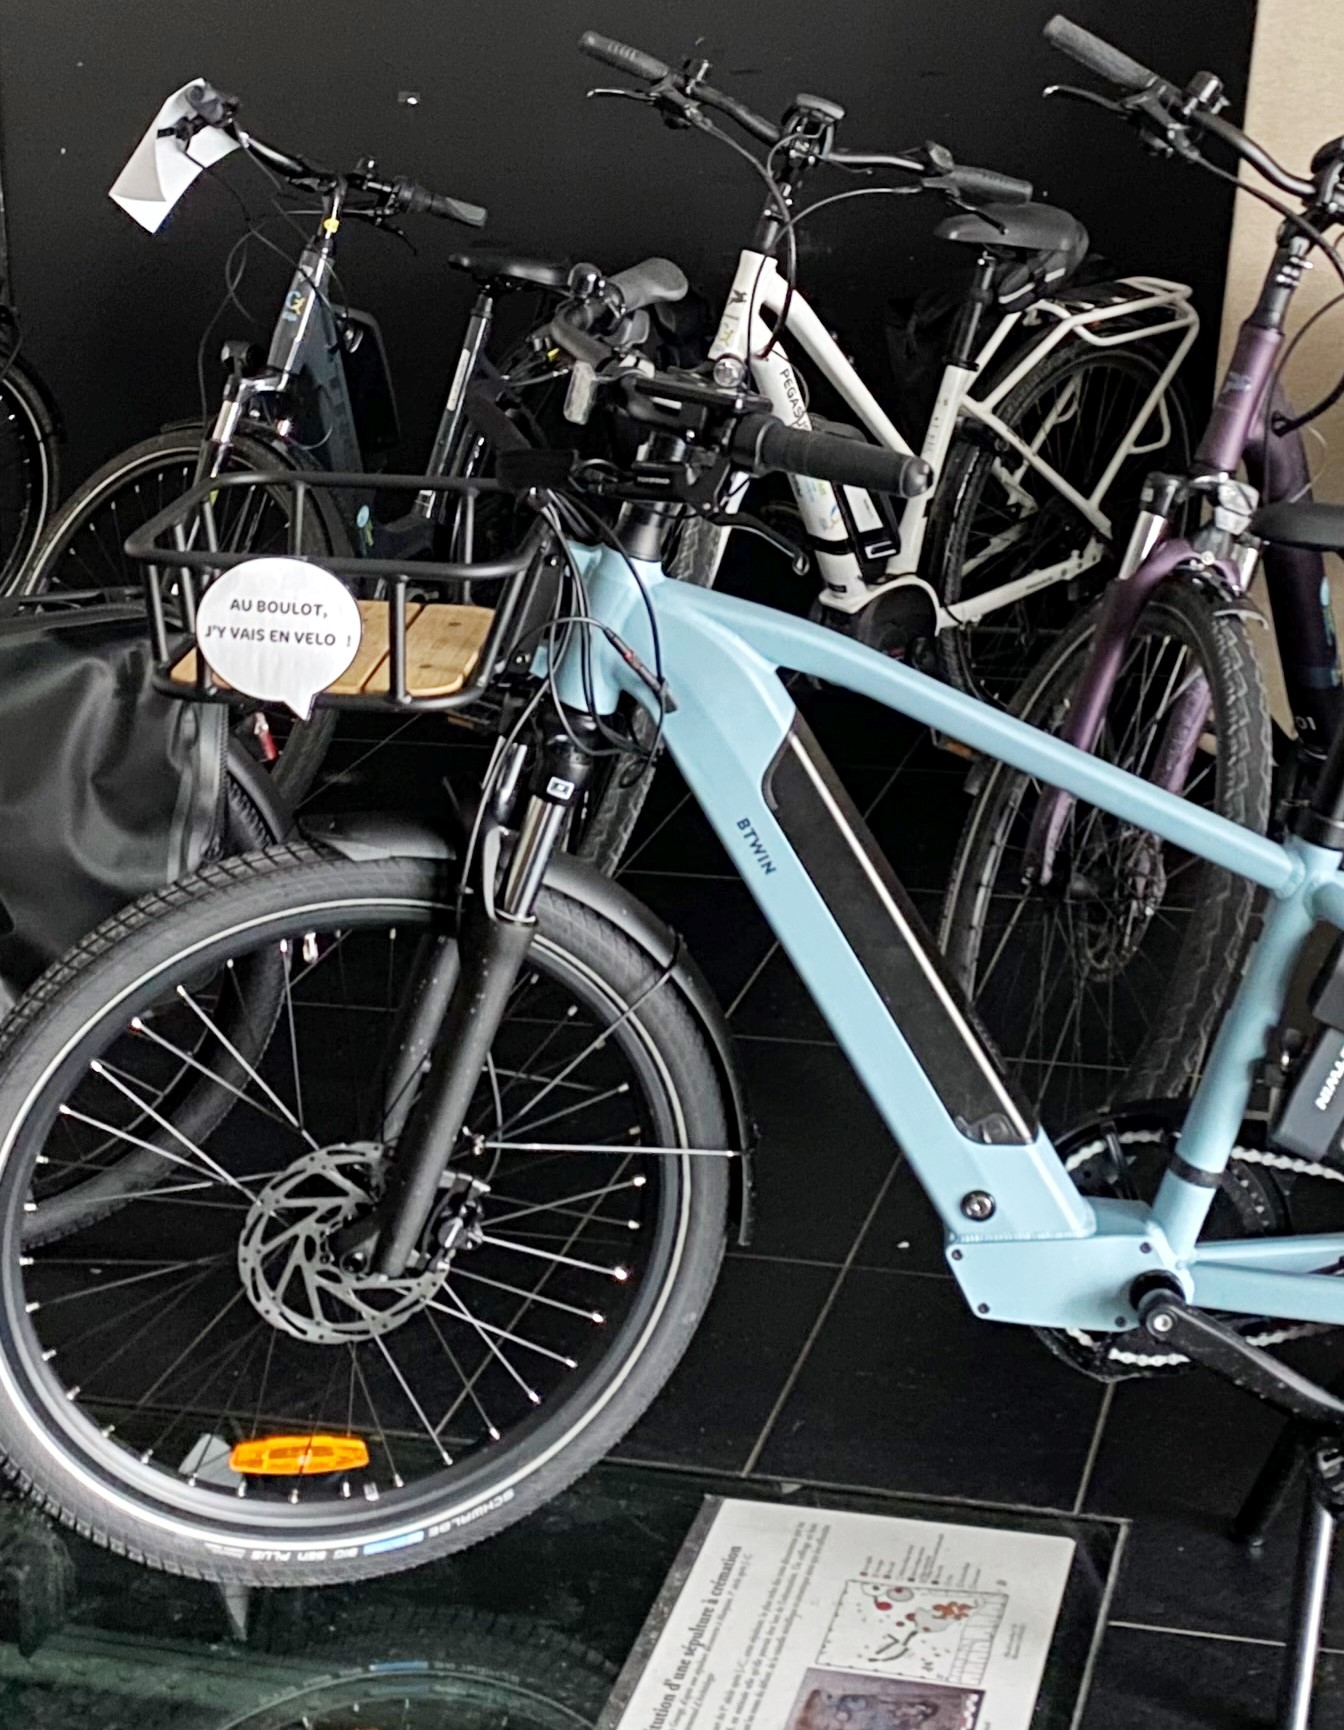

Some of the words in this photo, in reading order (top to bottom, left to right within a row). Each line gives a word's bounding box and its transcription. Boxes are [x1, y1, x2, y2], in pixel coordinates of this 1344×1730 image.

[779, 367, 809, 430] PEGASU
[205, 625, 227, 639] J'Y
[230, 627, 265, 642] VAIS
[269, 630, 290, 643] EN
[294, 632, 337, 646] VELO
[230, 598, 253, 612] AU
[256, 600, 328, 619] BOULOT,
[737, 817, 777, 876] BTWIN
[427, 1487, 515, 1538] SCHWALBE
[644, 1692, 676, 1730] tution
[664, 1658, 692, 1692] d'une
[681, 1606, 715, 1658] sépulture
[709, 1545, 743, 1598] crémation
